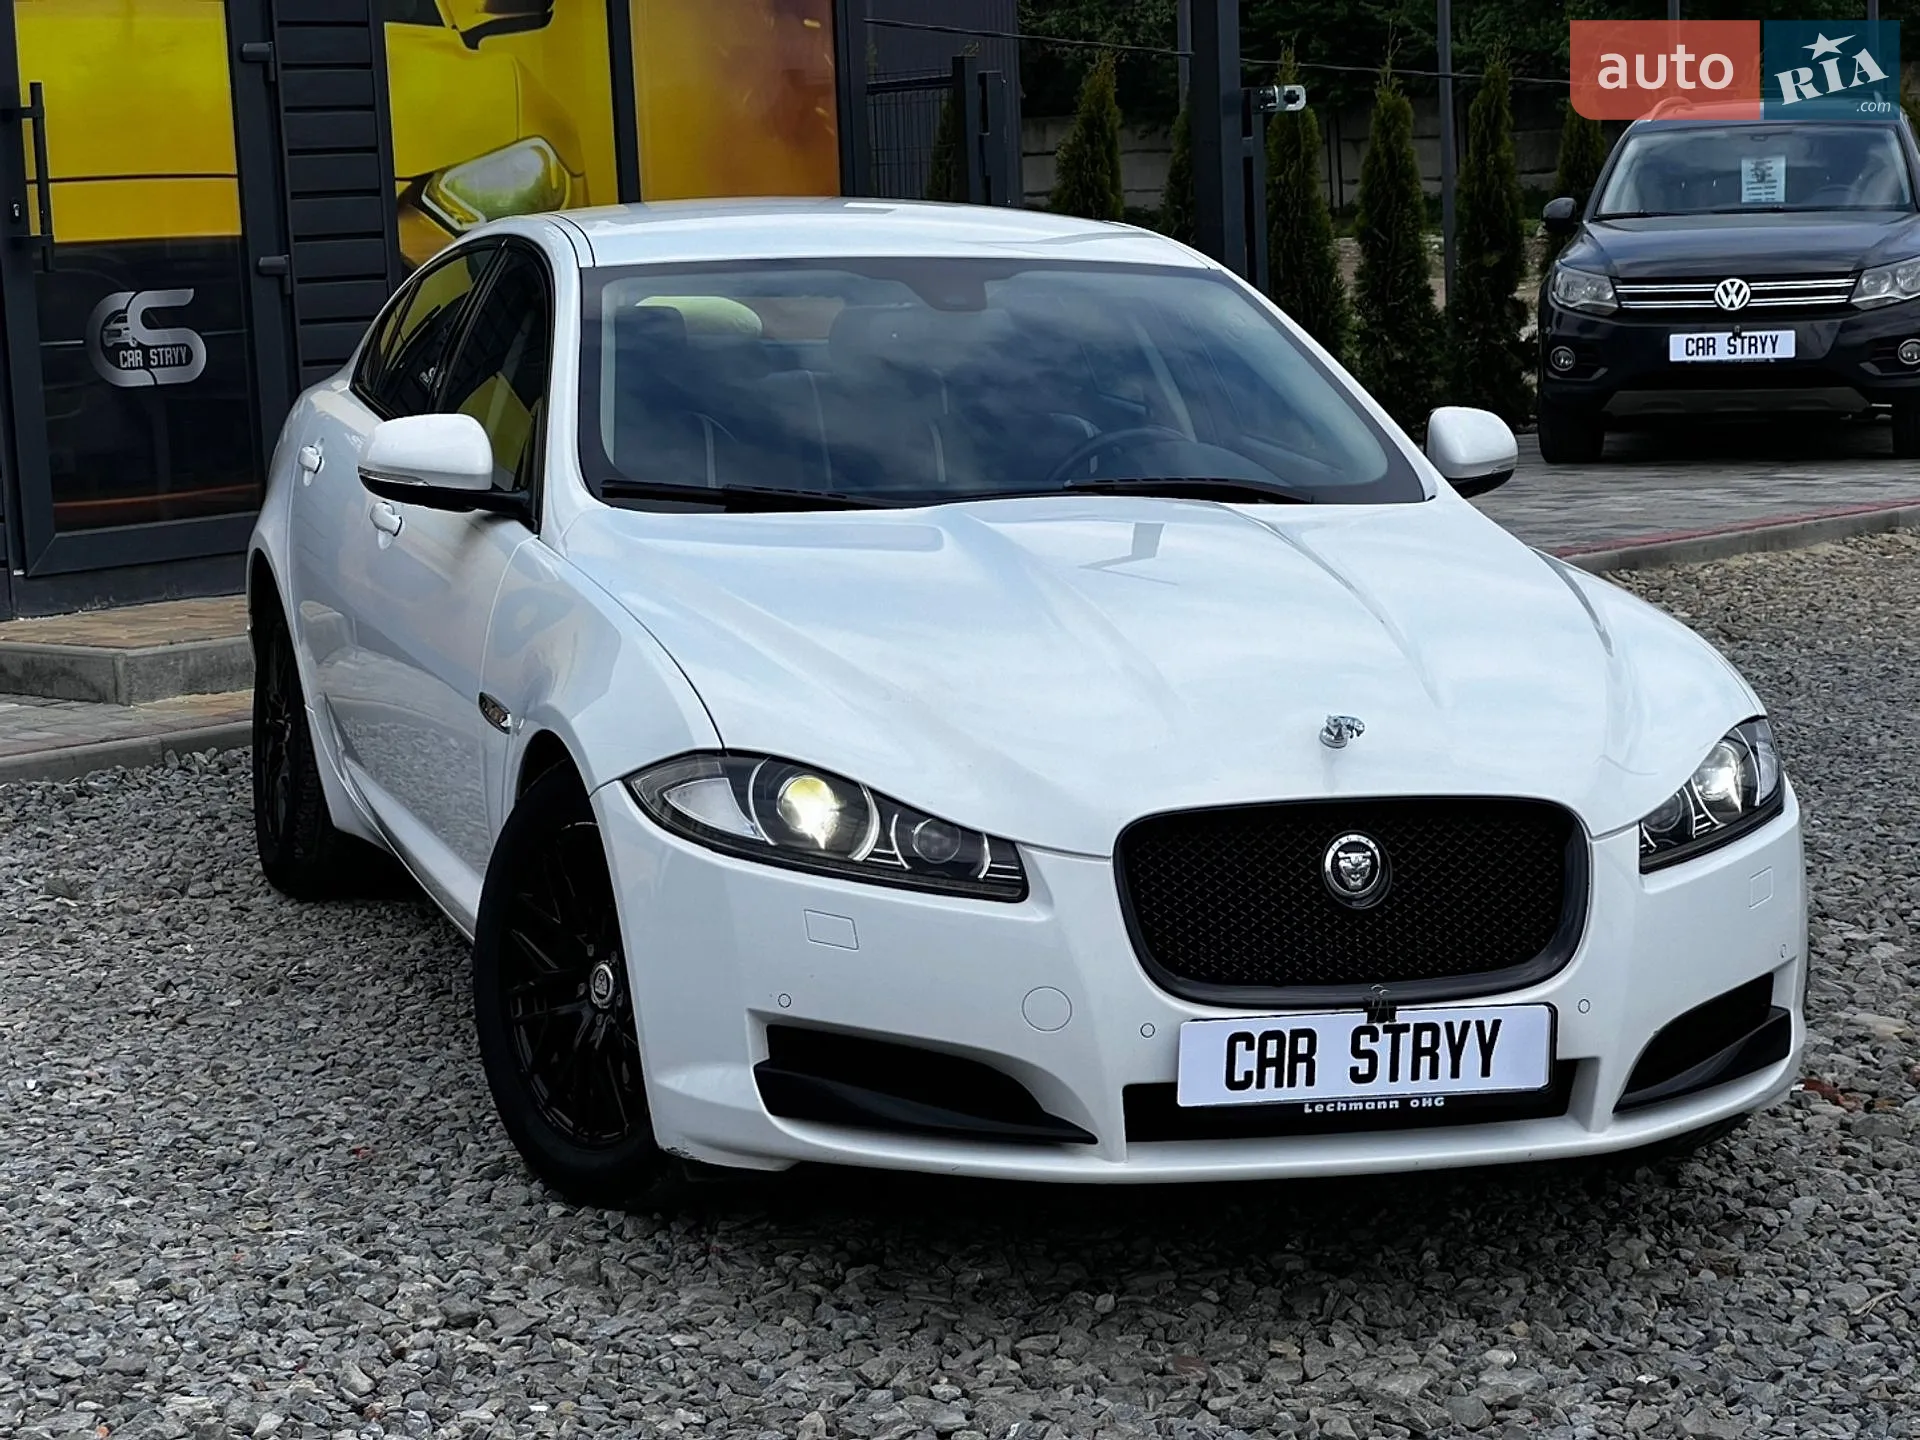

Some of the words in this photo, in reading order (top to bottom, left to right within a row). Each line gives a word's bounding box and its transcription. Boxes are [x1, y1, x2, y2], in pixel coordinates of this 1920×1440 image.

[1685, 337, 1716, 357] CAR
[1727, 334, 1779, 356] STRYY
[119, 349, 143, 368] CAR
[149, 346, 187, 366] STRYY
[1224, 1028, 1317, 1092] CAR
[1349, 1018, 1503, 1085] STRYY
[1304, 1099, 1400, 1114] Lechmann
